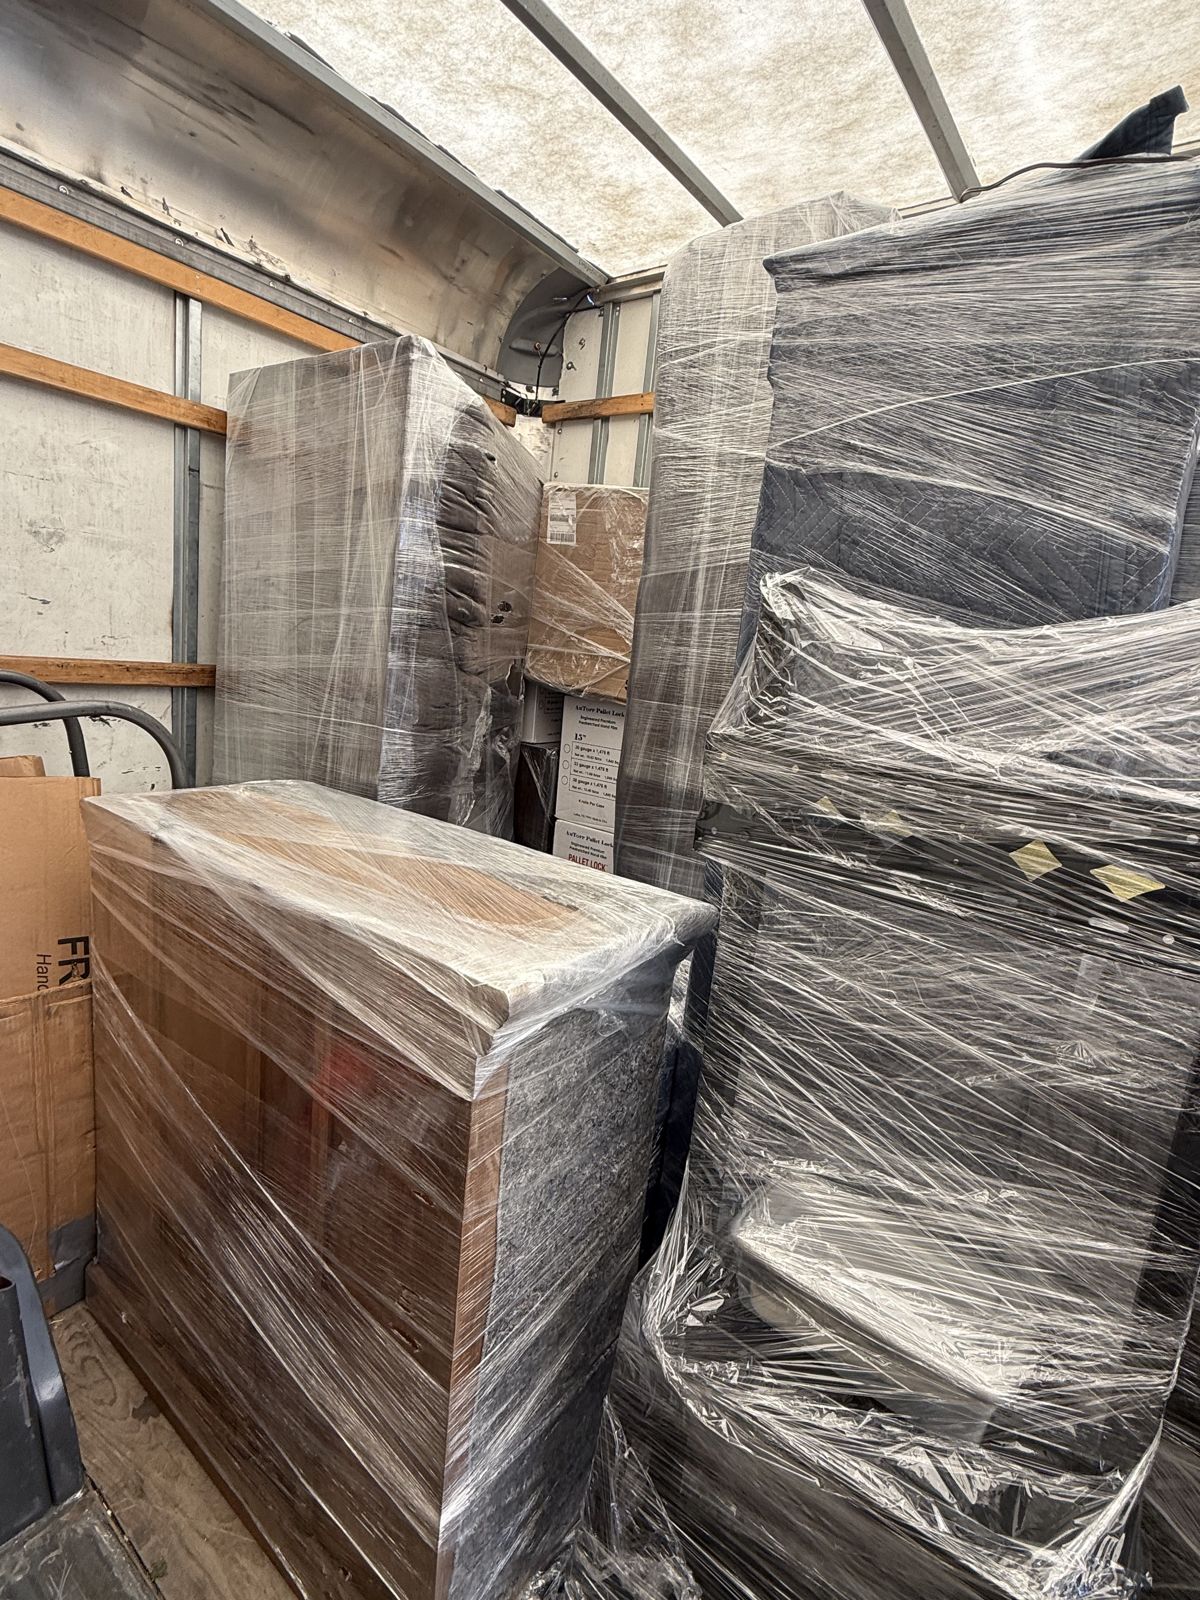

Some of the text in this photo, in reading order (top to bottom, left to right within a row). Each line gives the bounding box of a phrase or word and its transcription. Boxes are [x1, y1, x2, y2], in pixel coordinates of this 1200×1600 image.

[596, 707, 610, 715] Pallet
[586, 836, 600, 844] Pallet
[568, 854, 589, 866] PALLET
